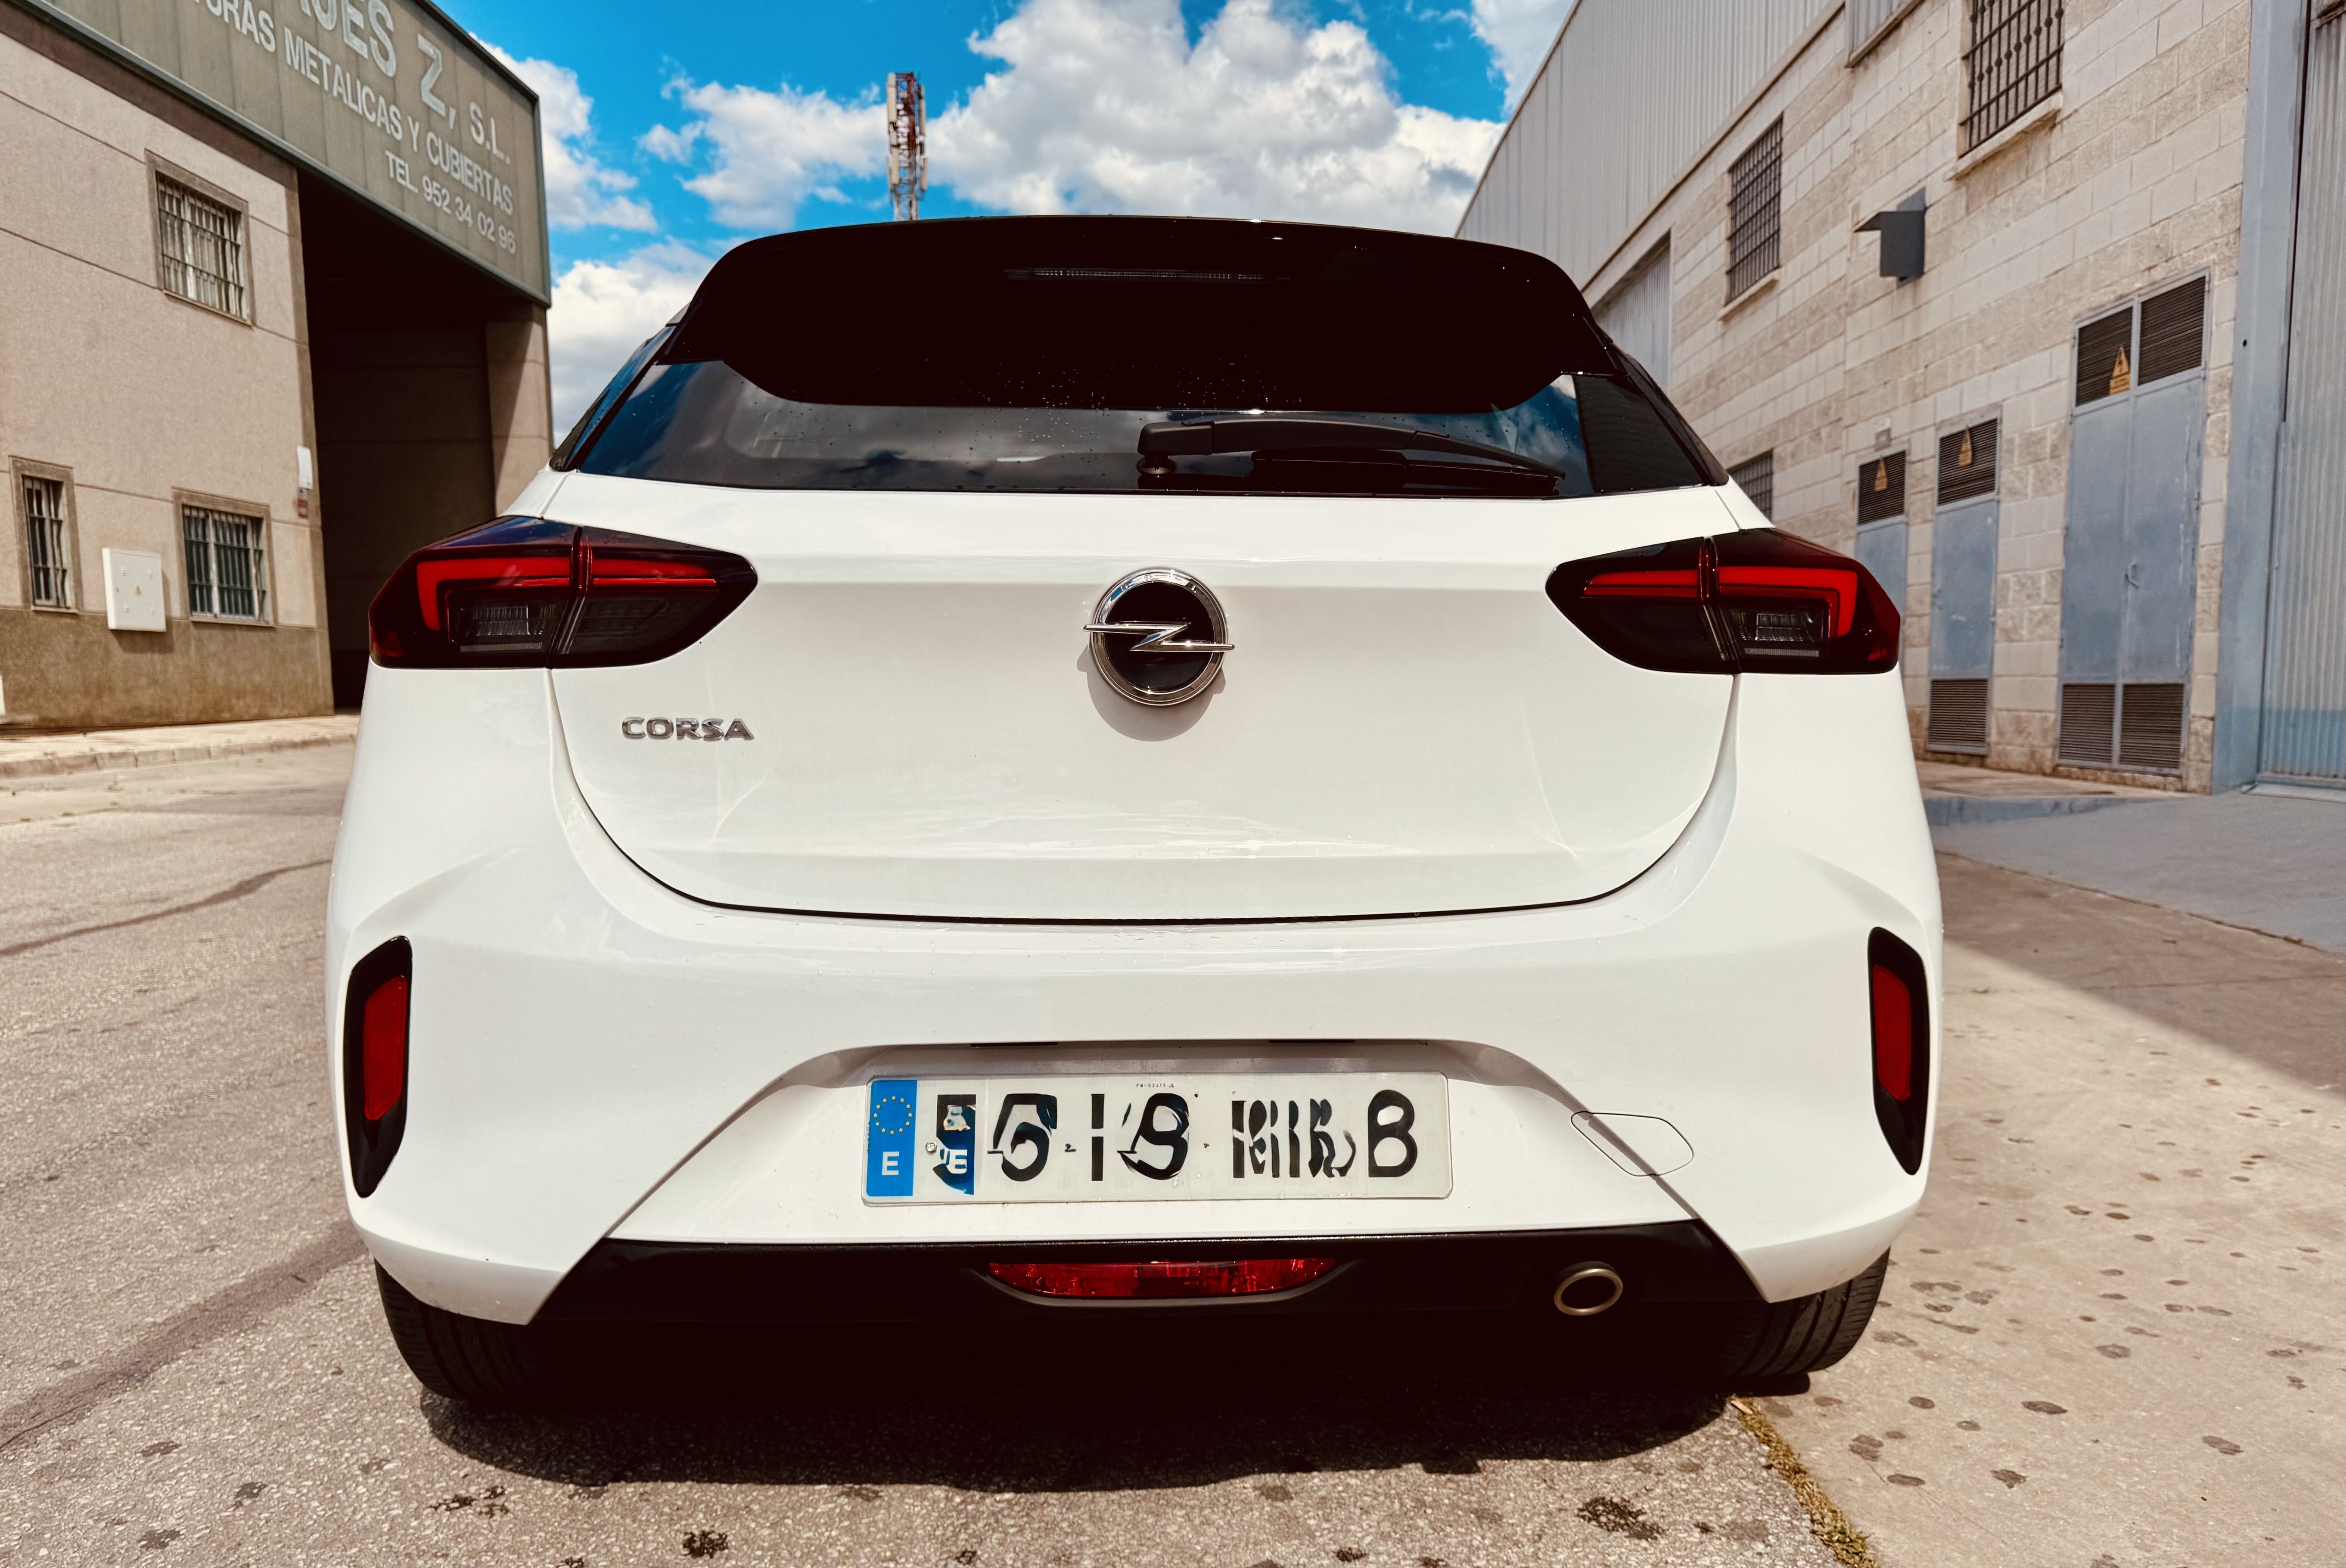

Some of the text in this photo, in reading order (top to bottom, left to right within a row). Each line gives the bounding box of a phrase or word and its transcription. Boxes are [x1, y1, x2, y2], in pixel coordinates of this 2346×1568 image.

[284, 26, 403, 141] METALICAS
[407, 115, 422, 152] Y
[426, 130, 513, 215] CUBIERTAS
[299, 0, 396, 77] ES
[470, 101, 510, 165] S.L.
[422, 175, 452, 214] 952
[455, 196, 473, 227] 34
[477, 211, 496, 242] 02
[498, 224, 516, 254] 96
[622, 717, 755, 742] CORSA
[882, 1151, 899, 1176] E
